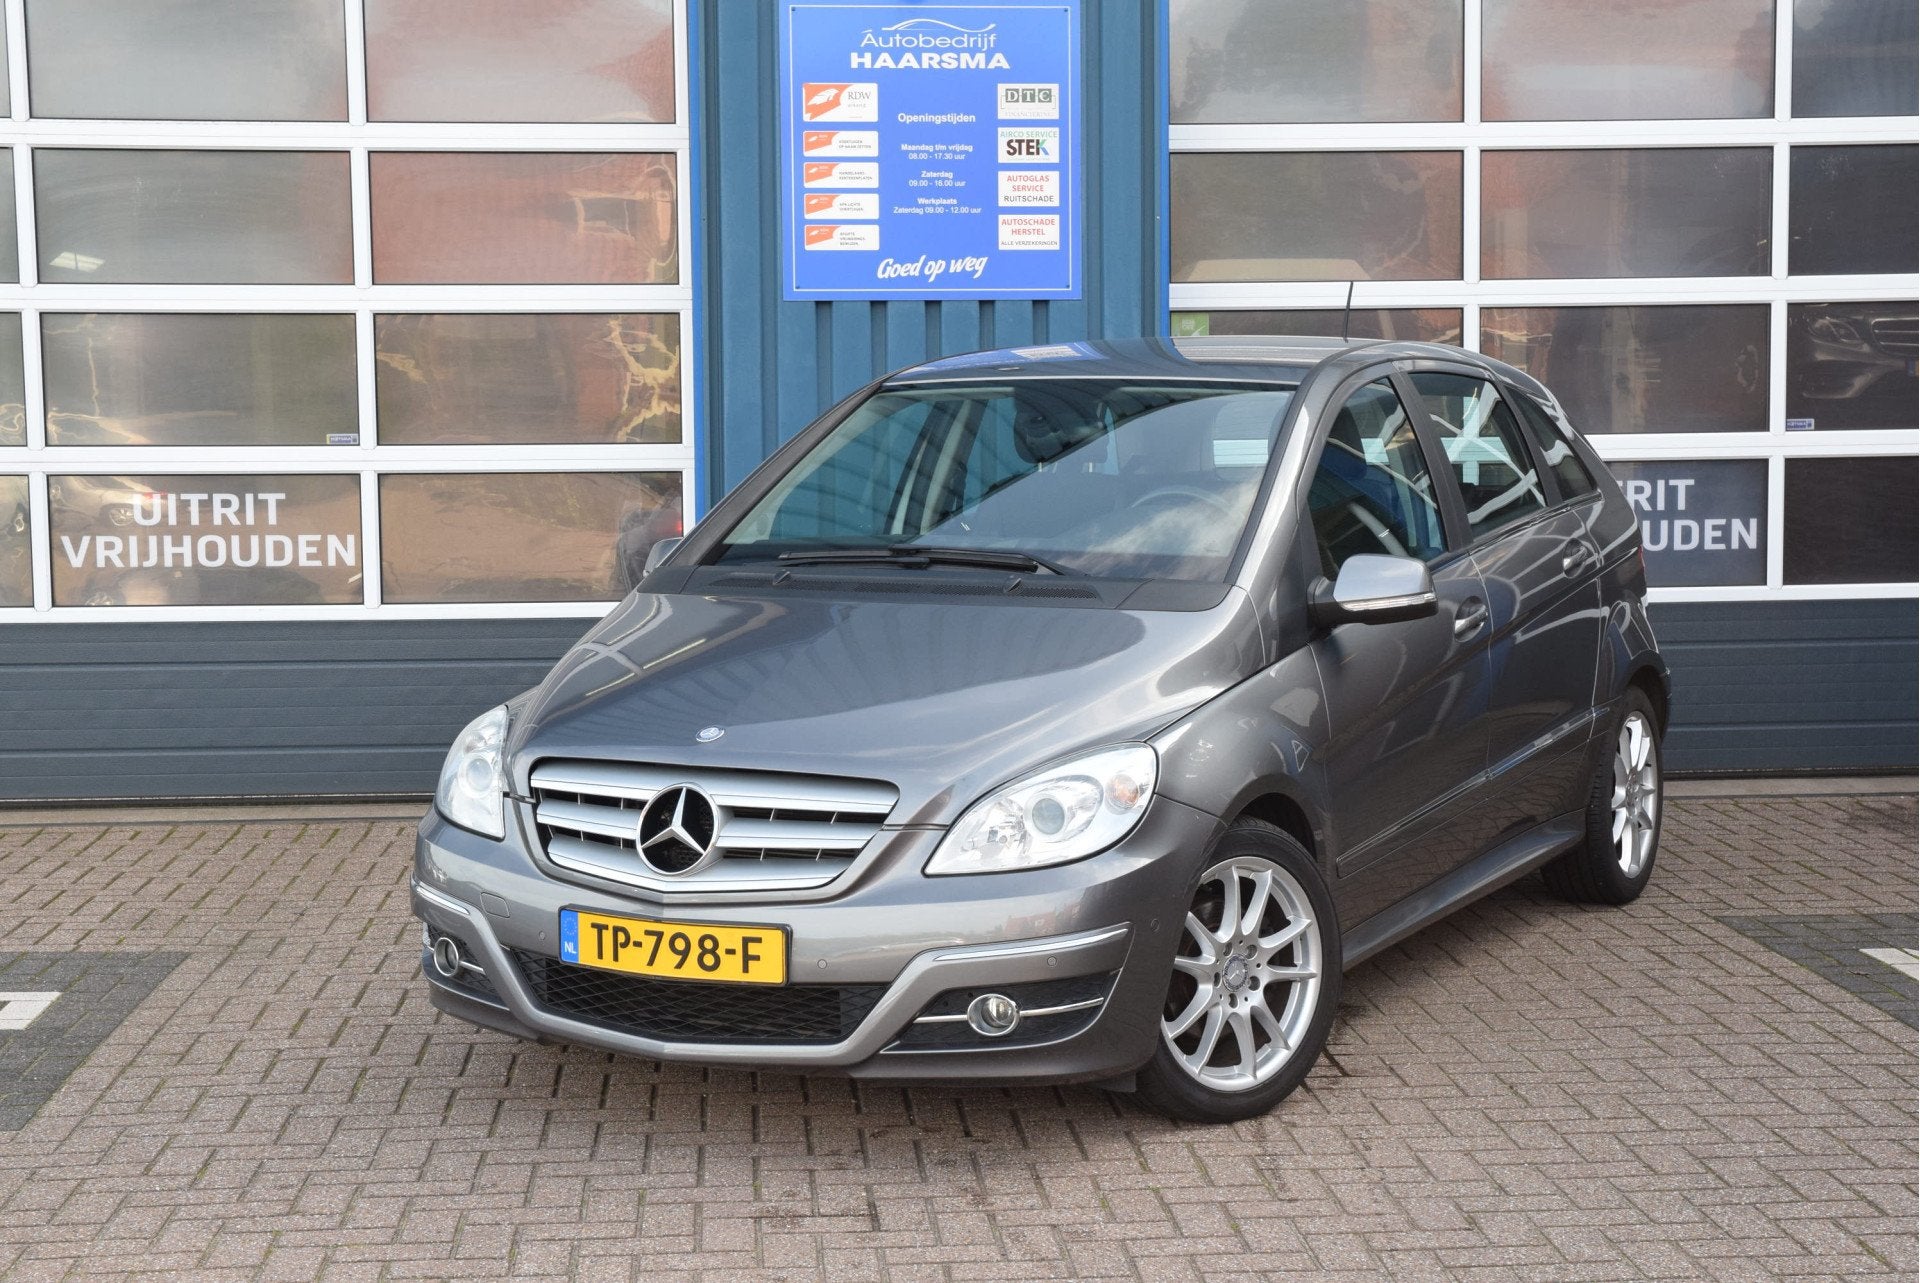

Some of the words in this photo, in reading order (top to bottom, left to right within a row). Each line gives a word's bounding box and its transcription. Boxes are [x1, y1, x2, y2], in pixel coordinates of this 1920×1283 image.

[850, 52, 1010, 69] HAARSMA
[848, 91, 871, 100] RDW
[1006, 89, 1051, 102] DTC
[898, 112, 976, 124] Openingstijden
[1000, 130, 1024, 138] AIRCO
[1026, 130, 1058, 138] SERVICE
[901, 144, 934, 152] Maandag
[948, 144, 973, 152] vrijdag
[1006, 139, 1049, 156] STEK
[921, 171, 954, 179] Zaterdag
[917, 198, 958, 206] Werkplaats
[893, 206, 924, 215] Zaterdag
[925, 206, 944, 214] 09.00
[951, 206, 969, 214] 12.00
[877, 255, 926, 279] Goed
[924, 259, 946, 283] op
[949, 256, 988, 279] weg
[1616, 479, 1695, 511] RIT
[133, 493, 286, 526] UITRIT
[60, 534, 356, 568] VRIJHOUDEN
[564, 941, 577, 954] NL
[591, 922, 763, 974] TP-798-F
